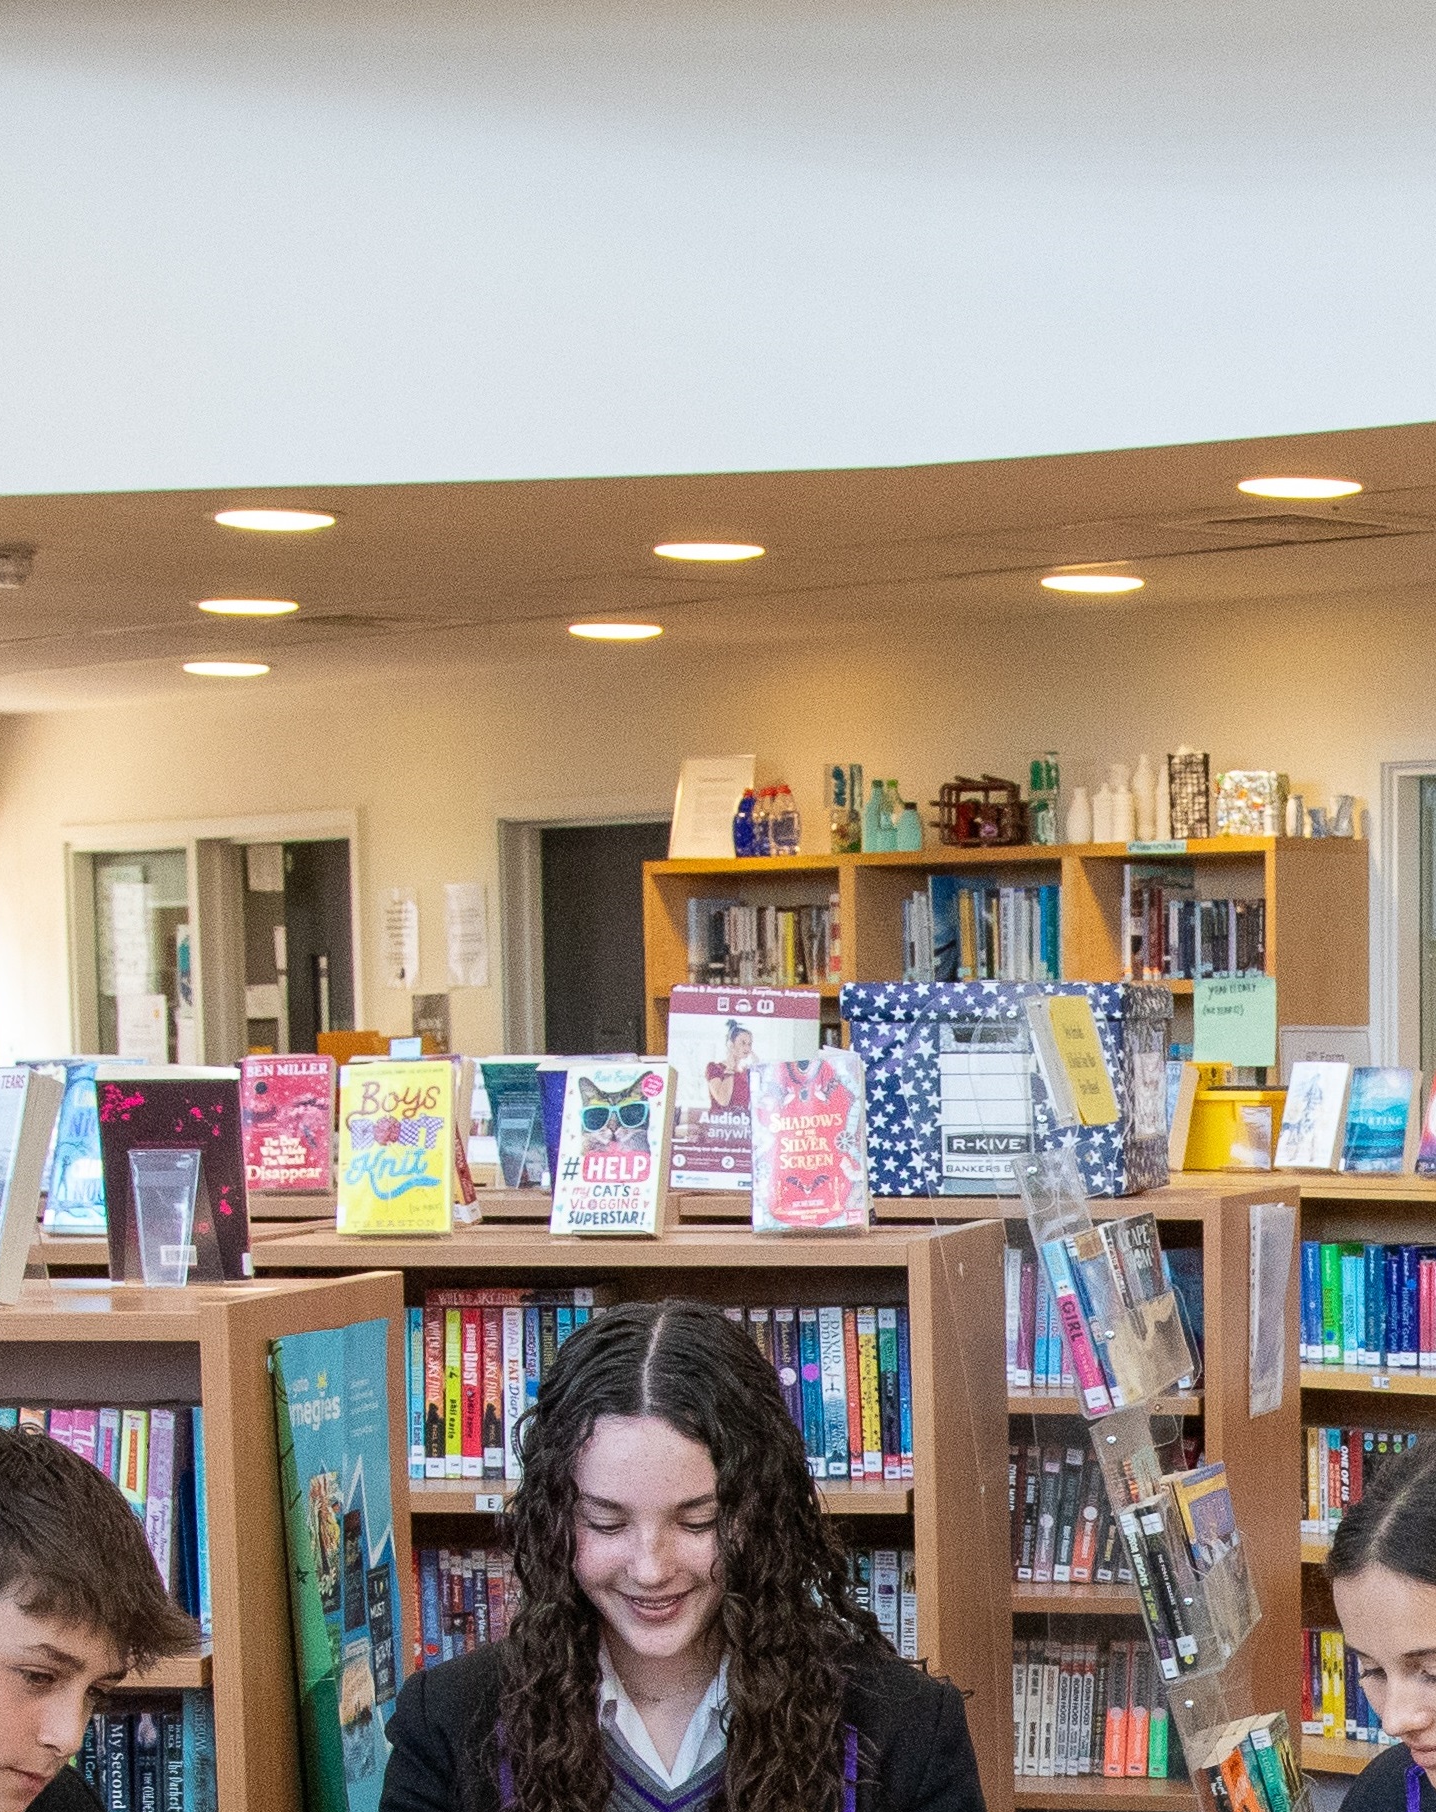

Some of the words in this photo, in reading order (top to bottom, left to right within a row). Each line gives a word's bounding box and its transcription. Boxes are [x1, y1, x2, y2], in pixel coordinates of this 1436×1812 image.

[246, 1063, 274, 1077] BEN
[276, 1062, 329, 1077] MILLER
[1, 1074, 25, 1089] TEARS
[357, 1081, 441, 1118] Boys
[768, 1112, 844, 1133] SHADOWS
[780, 1137, 831, 1153] SILVER
[952, 1137, 1022, 1151] R-KIVE
[345, 1148, 430, 1190] Knit
[779, 1153, 834, 1170] SCREEN
[946, 1164, 1001, 1174] BANKERS
[246, 1165, 323, 1182] Disappear
[571, 1187, 591, 1199] my
[592, 1184, 631, 1198] CAT'S
[633, 1188, 641, 1196] a
[570, 1198, 639, 1211] VLOGGING
[567, 1211, 646, 1226] SUPERSTAR!
[1061, 1300, 1083, 1343] GIRL
[820, 1312, 832, 1372] EDDINGS
[831, 1320, 841, 1364] DAVID
[463, 1353, 479, 1386] DAISY
[508, 1359, 519, 1383] FAT
[507, 1383, 520, 1419] Diary
[1340, 1443, 1349, 1468] ONE
[109, 1724, 124, 1748] My
[168, 1760, 183, 1775] The
[112, 1752, 127, 1809] Second
[168, 1776, 184, 1812] Darkest
